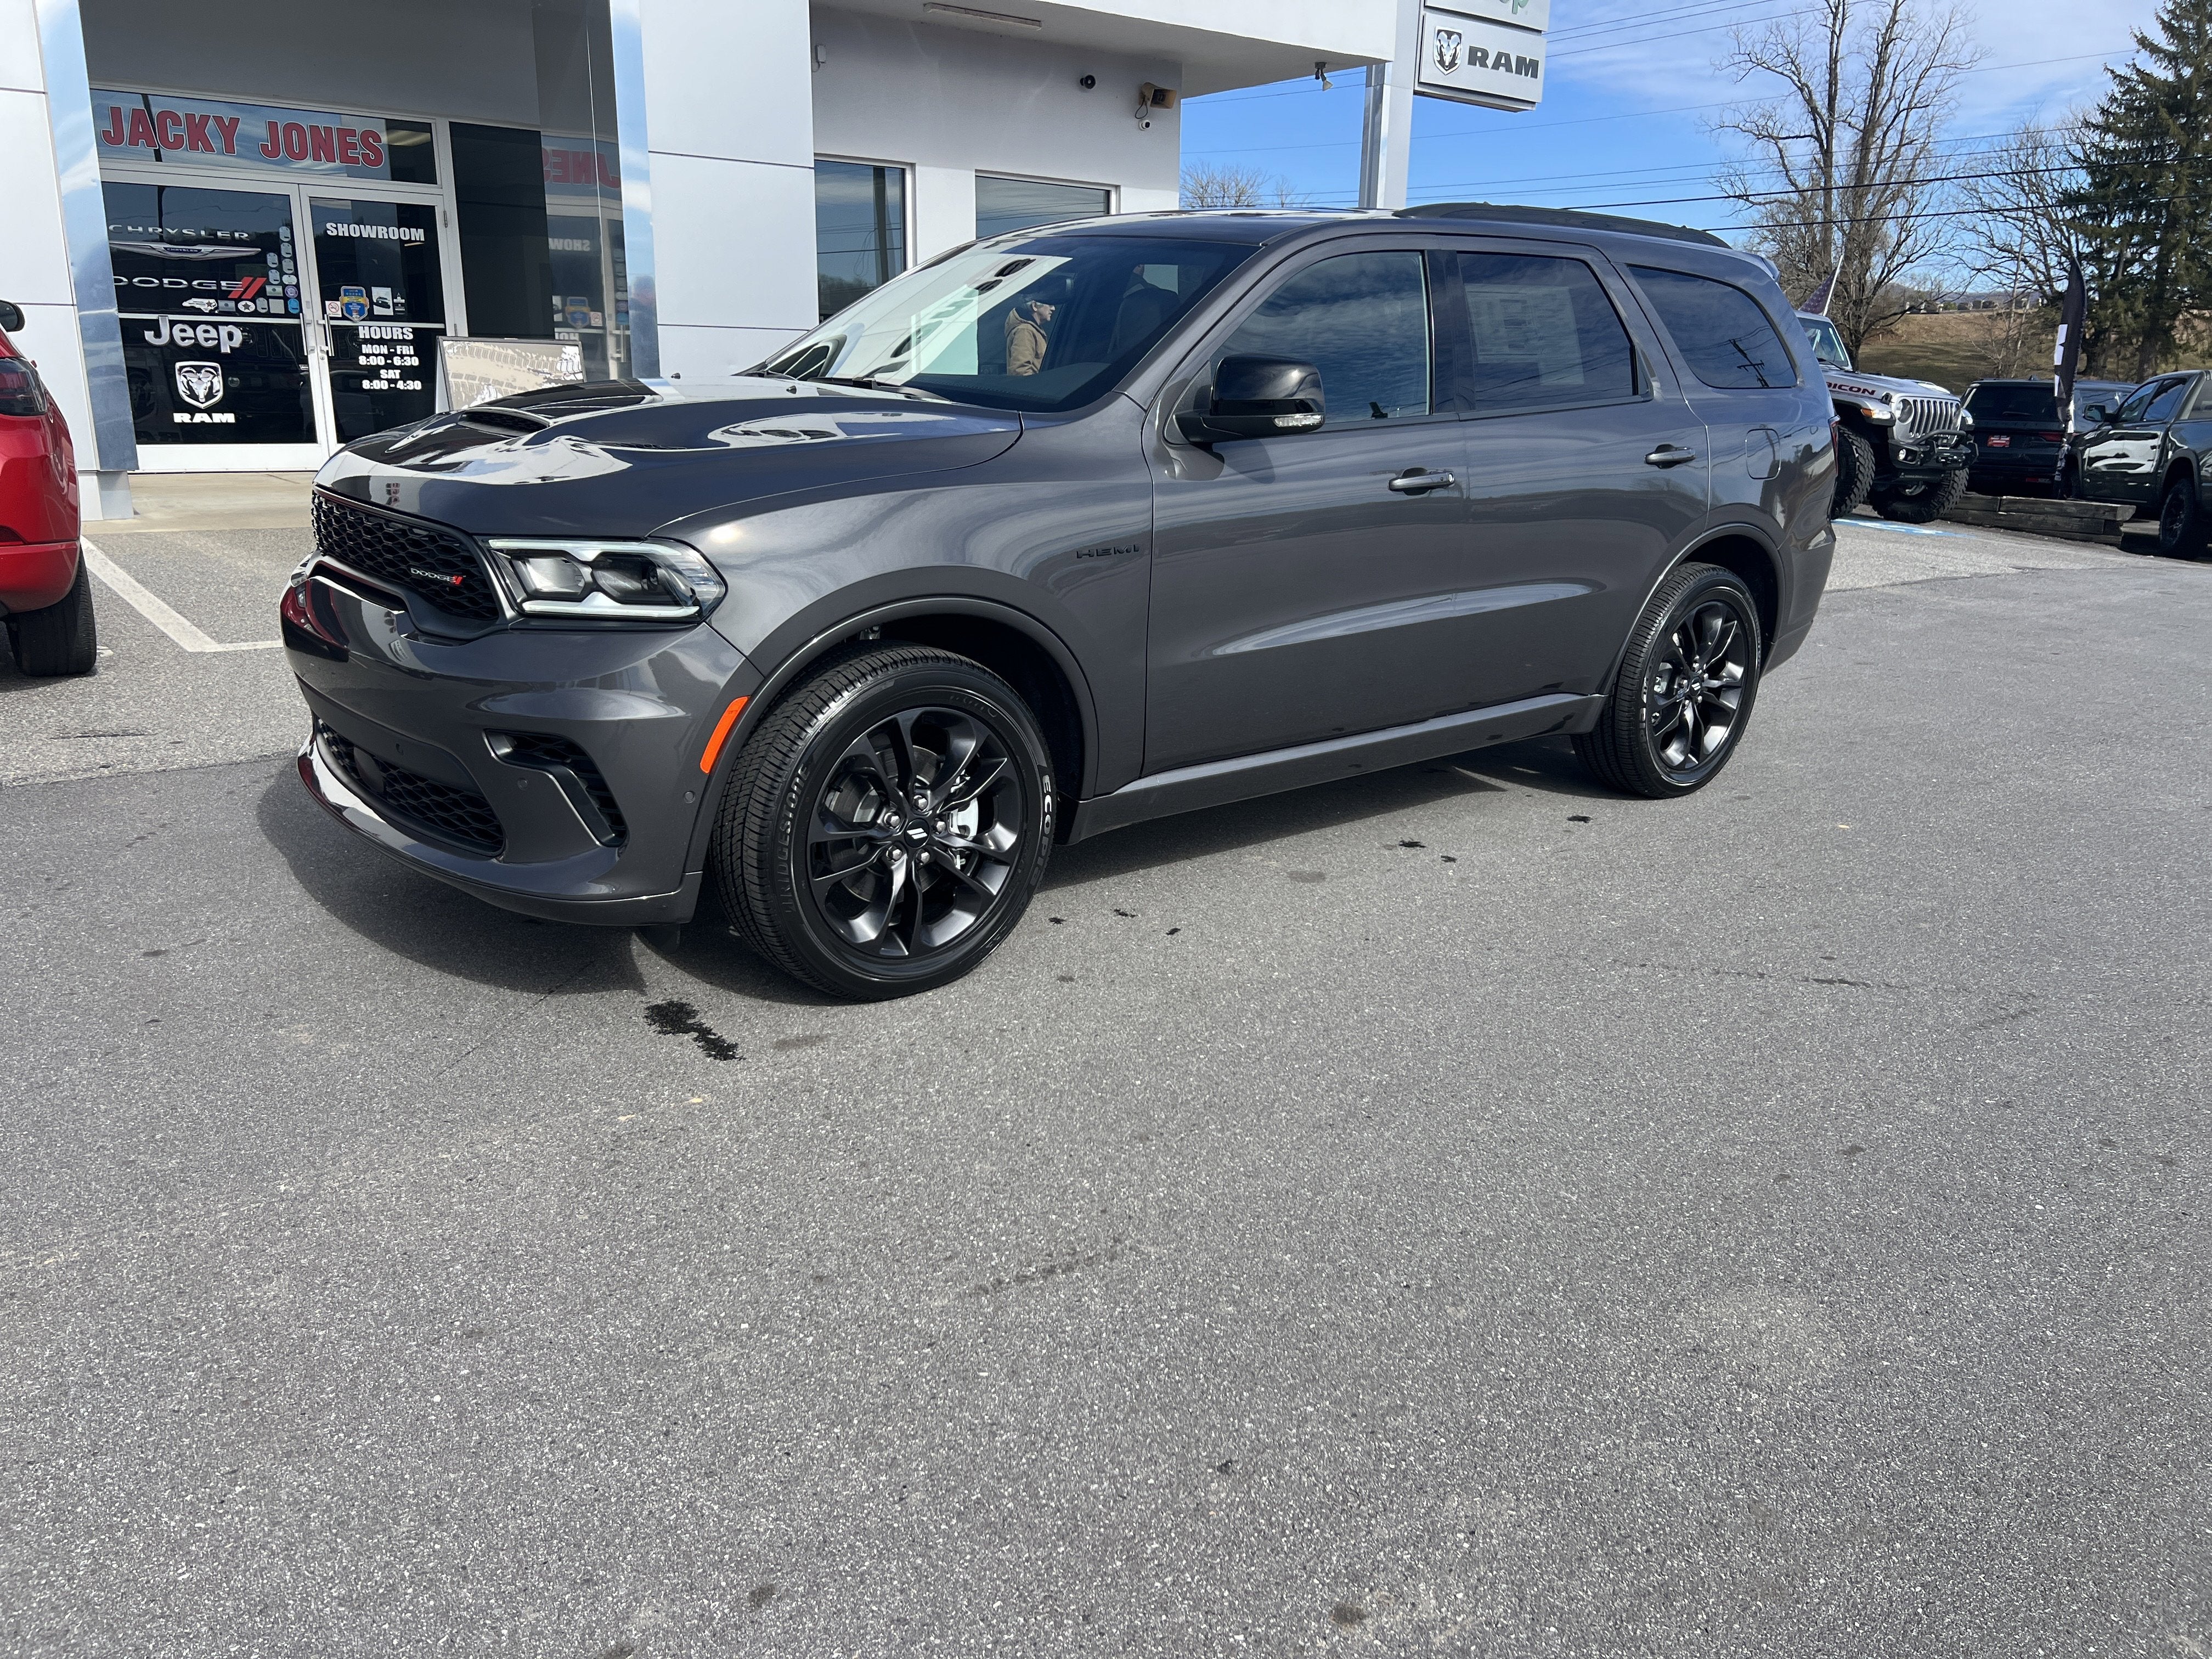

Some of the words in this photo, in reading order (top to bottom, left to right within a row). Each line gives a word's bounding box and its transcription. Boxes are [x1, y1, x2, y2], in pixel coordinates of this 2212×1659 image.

[1468, 46, 1539, 79] RAM
[101, 106, 240, 156] JACKY
[259, 120, 385, 168] JONES
[109, 224, 250, 241] CHRYSLER
[325, 222, 425, 241] SHOWROOM
[113, 276, 243, 291] DODGE
[144, 315, 242, 354] Jeep
[358, 326, 414, 340] HOURS
[362, 344, 388, 354] MON
[396, 345, 414, 355] FRI
[358, 356, 385, 366] 8:00
[393, 357, 419, 366] 6:30
[380, 369, 401, 379] SAT
[362, 380, 388, 390] 8:00
[396, 380, 422, 390] 4:30
[1826, 381, 1876, 396] ICON
[173, 413, 236, 424] RAM
[1076, 544, 1140, 558] HEMI
[411, 568, 456, 584] DODGE
